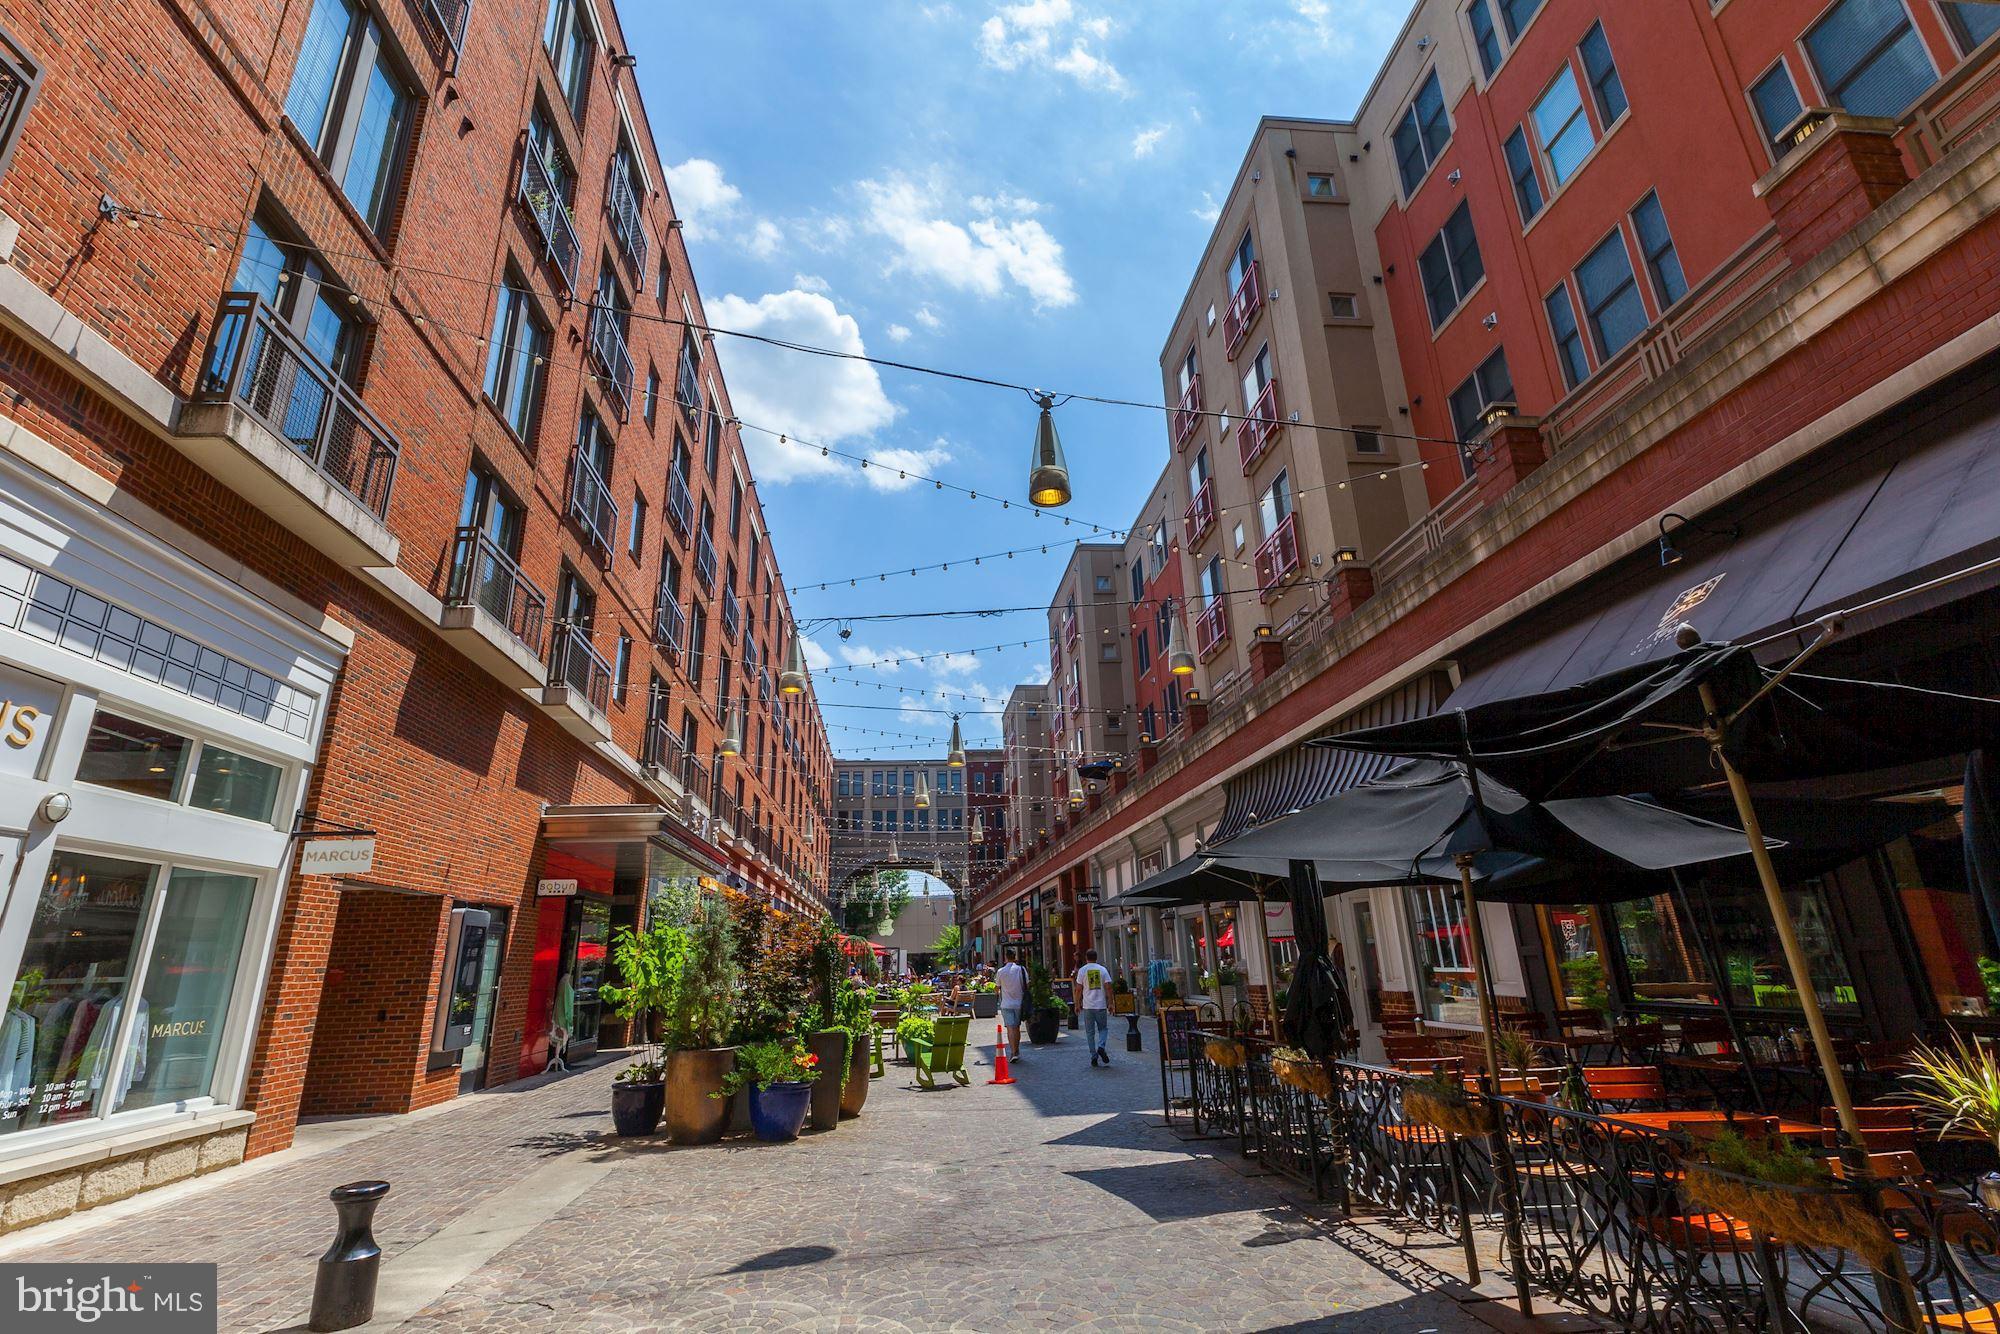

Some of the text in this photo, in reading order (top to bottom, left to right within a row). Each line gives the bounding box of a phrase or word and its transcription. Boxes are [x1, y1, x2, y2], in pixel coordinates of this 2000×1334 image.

[305, 849, 370, 863] MARCUS
[19, 1085, 37, 1096] Wed
[76, 1080, 87, 1089] pm
[18, 1097, 31, 1106] Sat
[73, 1090, 84, 1099] pm
[1, 1111, 17, 1119] Sun
[38, 1104, 48, 1114] 12
[70, 1100, 82, 1109] pm
